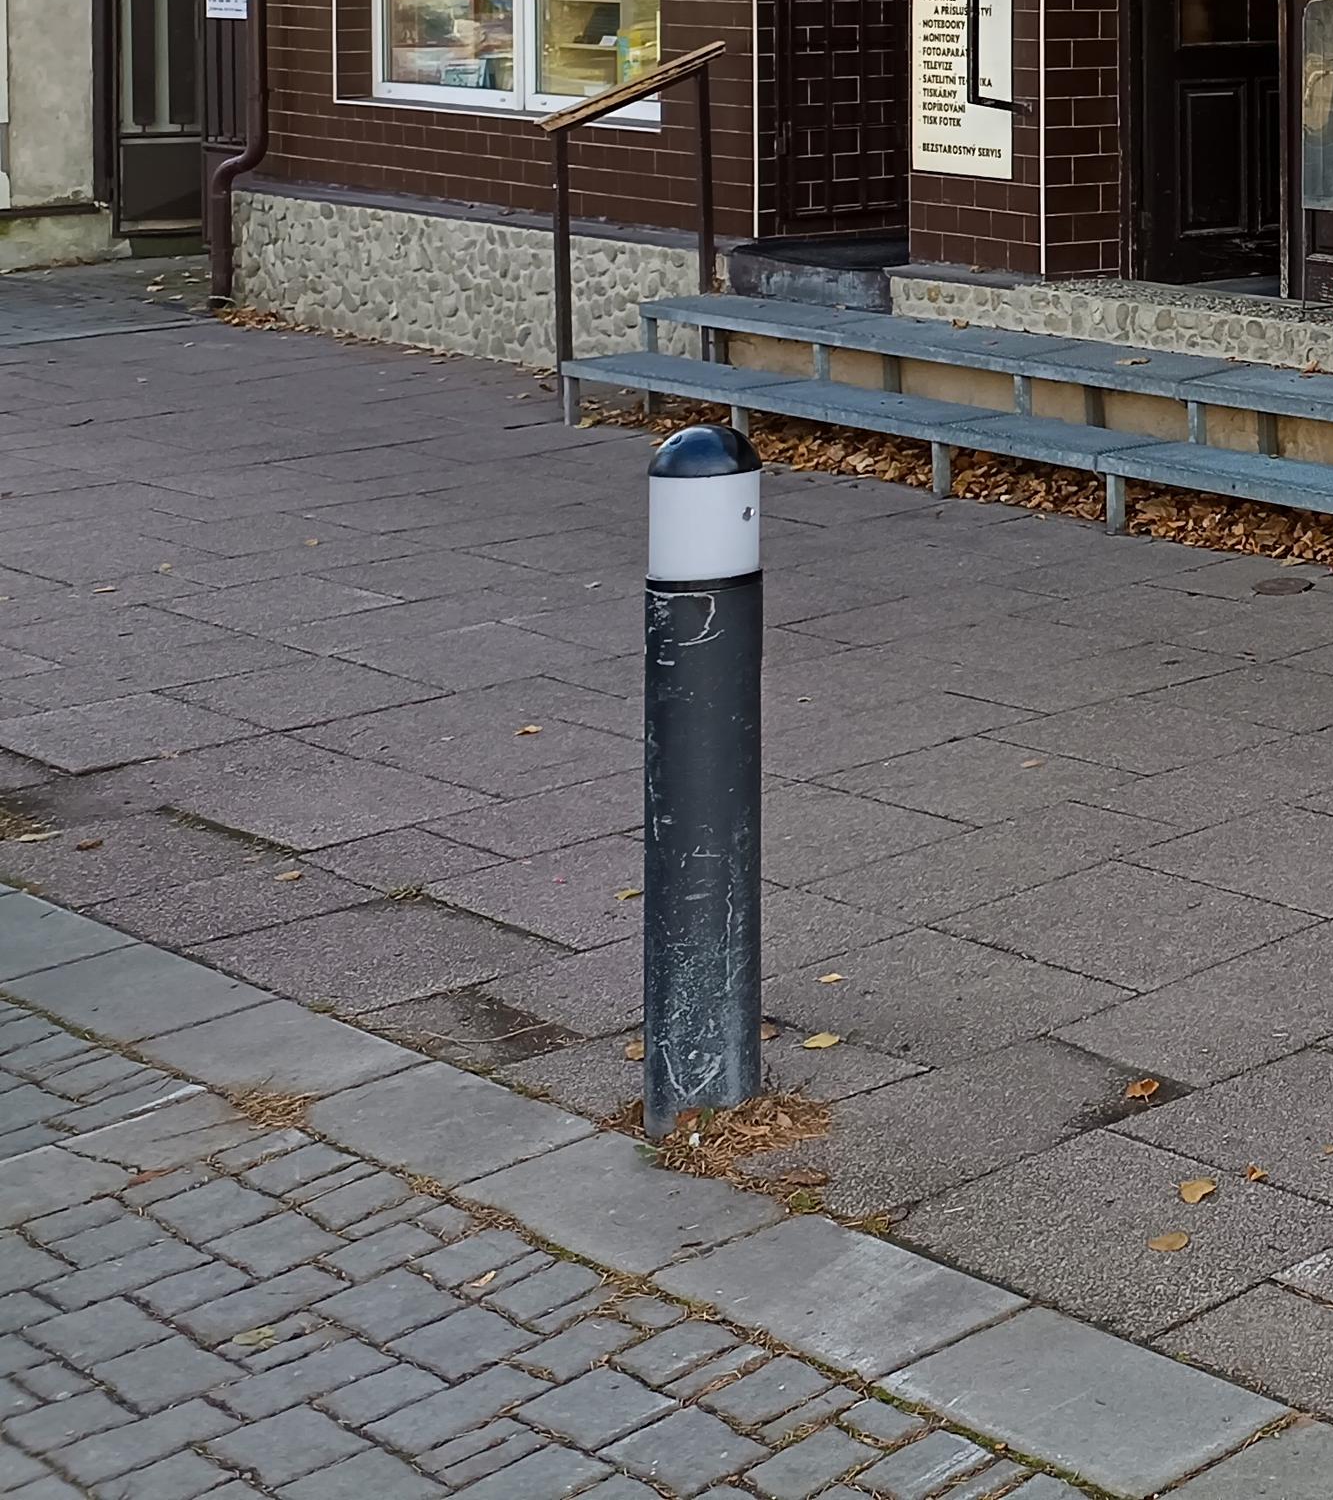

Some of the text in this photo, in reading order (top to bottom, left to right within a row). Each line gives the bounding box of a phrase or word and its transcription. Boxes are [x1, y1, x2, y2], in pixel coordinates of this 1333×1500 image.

[922, 19, 966, 30] NOTEBOOKY
[922, 33, 961, 44] MONITORY
[922, 60, 953, 71] TELEVIZE
[922, 73, 957, 85] SATELITNÍ
[922, 86, 958, 99] TISKÁRNY
[922, 99, 966, 113] KOPÍROVÁNÍ
[922, 115, 962, 128] TISK FOTEK
[922, 142, 1002, 159] BEZSTAROSTNÝ SERVIS
